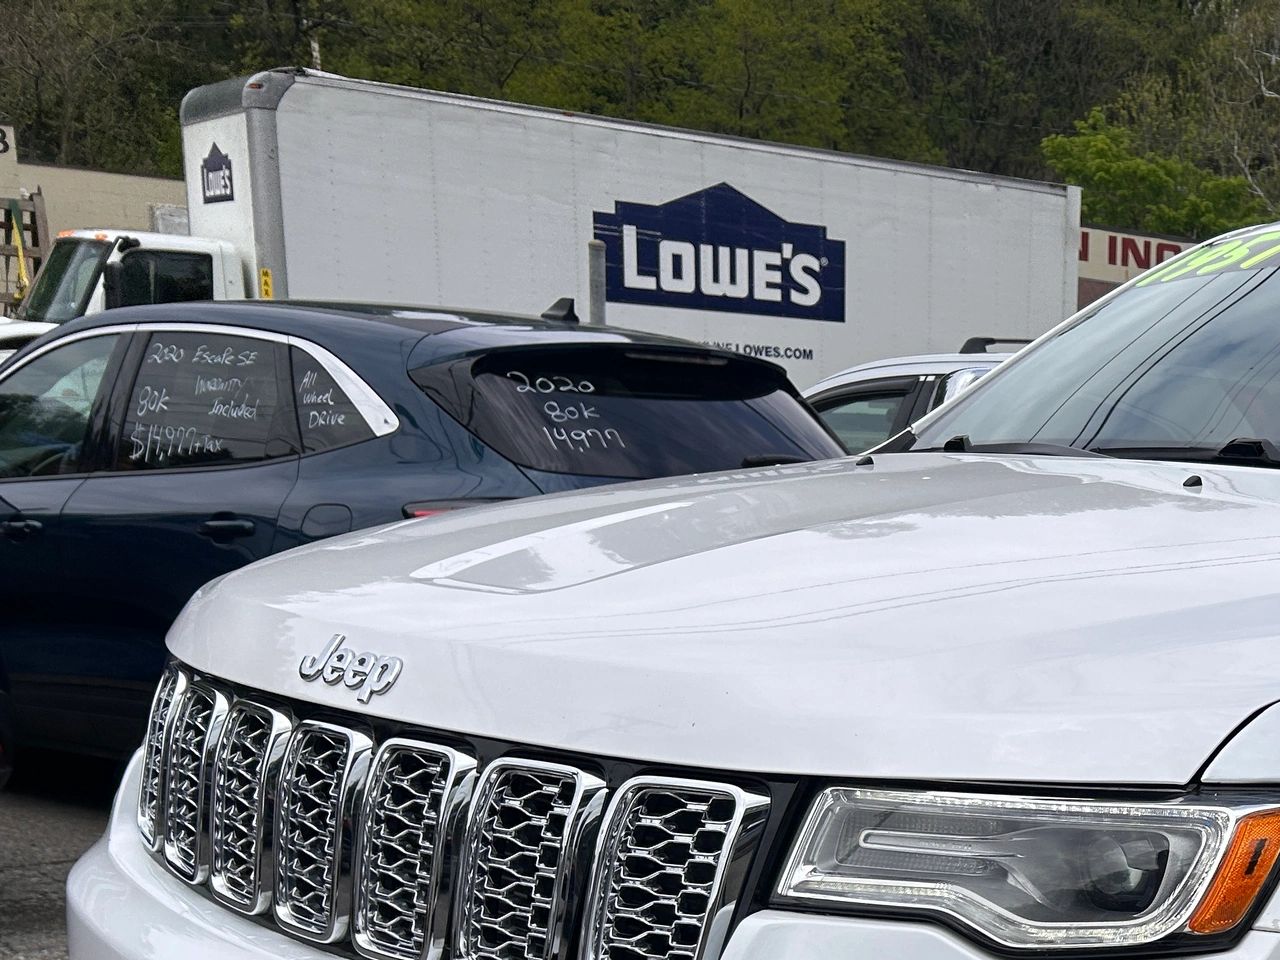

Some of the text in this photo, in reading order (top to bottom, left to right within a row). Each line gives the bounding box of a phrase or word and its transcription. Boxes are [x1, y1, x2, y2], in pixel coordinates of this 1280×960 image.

[204, 165, 232, 198] LOWE'S
[622, 224, 822, 307] LOWE'S
[147, 342, 185, 364] 2020
[299, 370, 318, 393] All
[506, 371, 595, 393] 2020
[542, 427, 626, 453] 14,977
[299, 633, 404, 705] Jeep
